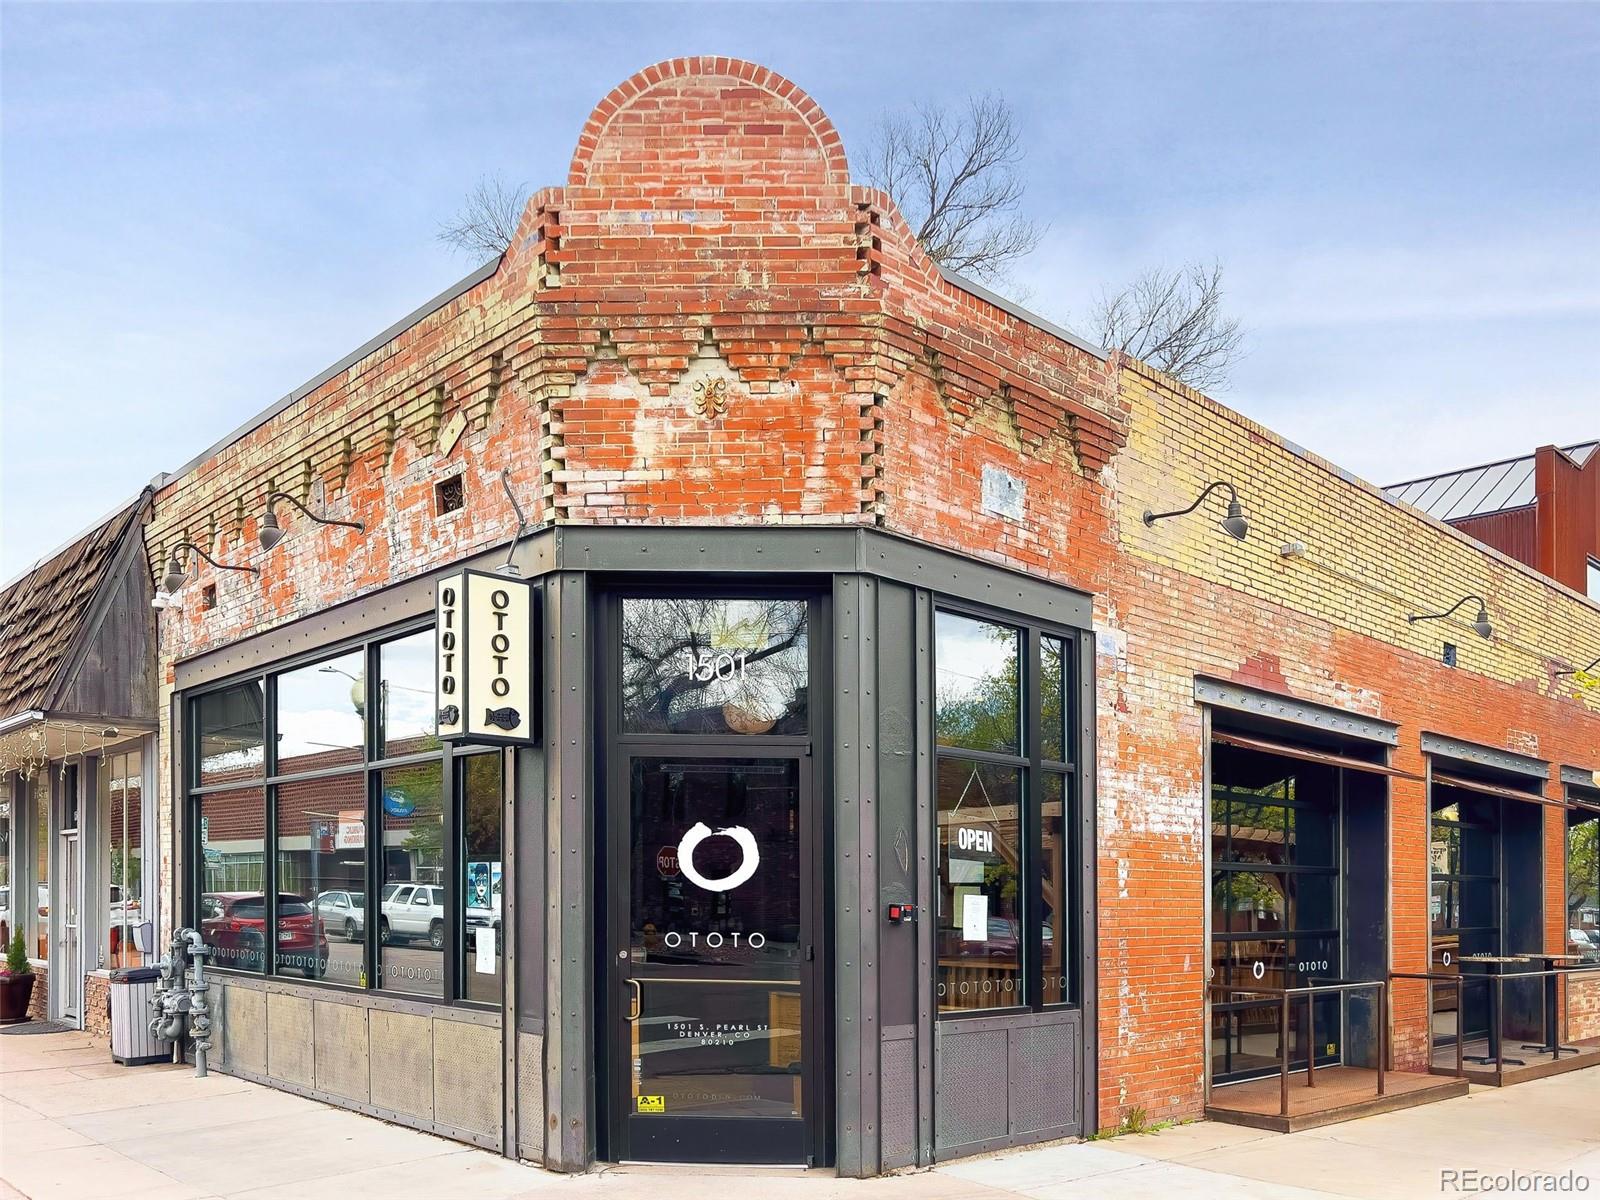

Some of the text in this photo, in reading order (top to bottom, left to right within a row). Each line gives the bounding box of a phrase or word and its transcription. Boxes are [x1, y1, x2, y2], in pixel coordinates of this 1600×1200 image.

[442, 587, 456, 695] OTOTO
[490, 589, 510, 697] OTOTO
[686, 653, 747, 682] 1501
[958, 827, 993, 853] OPEN
[664, 931, 766, 949] OTOTO
[1298, 960, 1328, 972] OTOTO
[699, 1023, 710, 1031] S.
[640, 1096, 662, 1105] A-1
